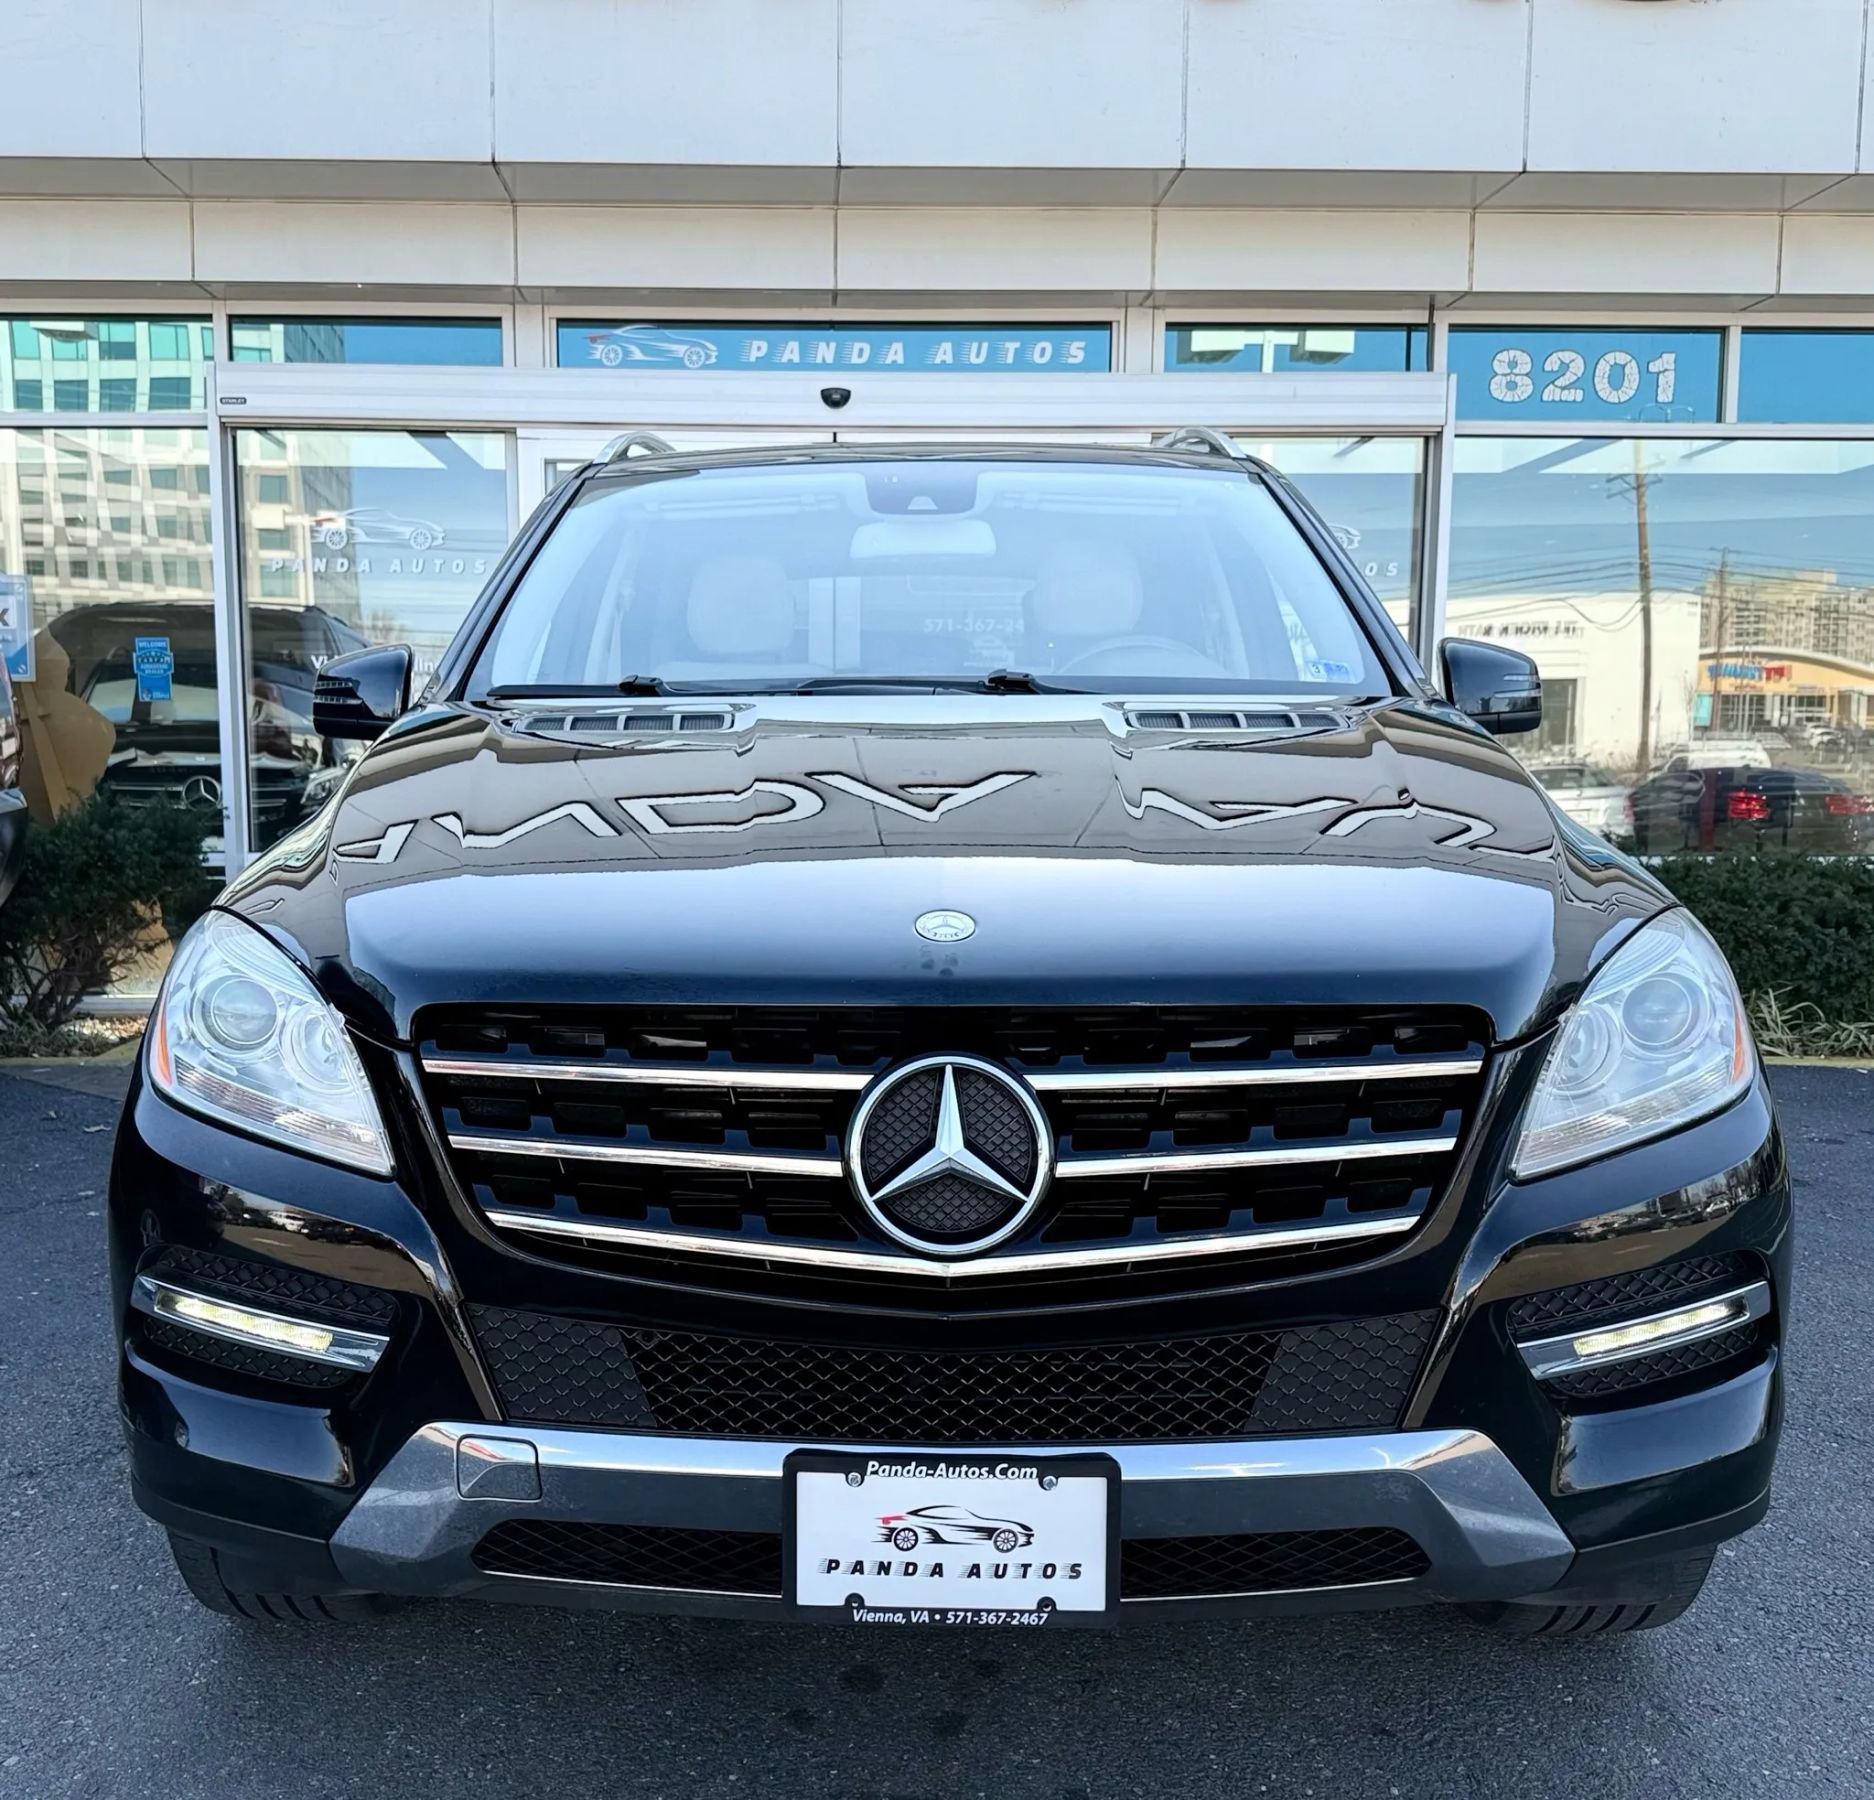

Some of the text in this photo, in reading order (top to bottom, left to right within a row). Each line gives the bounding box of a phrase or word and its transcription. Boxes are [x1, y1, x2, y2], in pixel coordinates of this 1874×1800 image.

[742, 340, 1088, 365] PANDA AUTOS
[1488, 348, 1676, 403] 8201
[271, 558, 487, 575] PANDA AUTOS
[866, 1461, 1038, 1480] Panda-Autos.Com
[818, 1558, 1083, 1580] PANDA AUTOS
[852, 1608, 1049, 1626] Vienna, VA 571-367-2467
